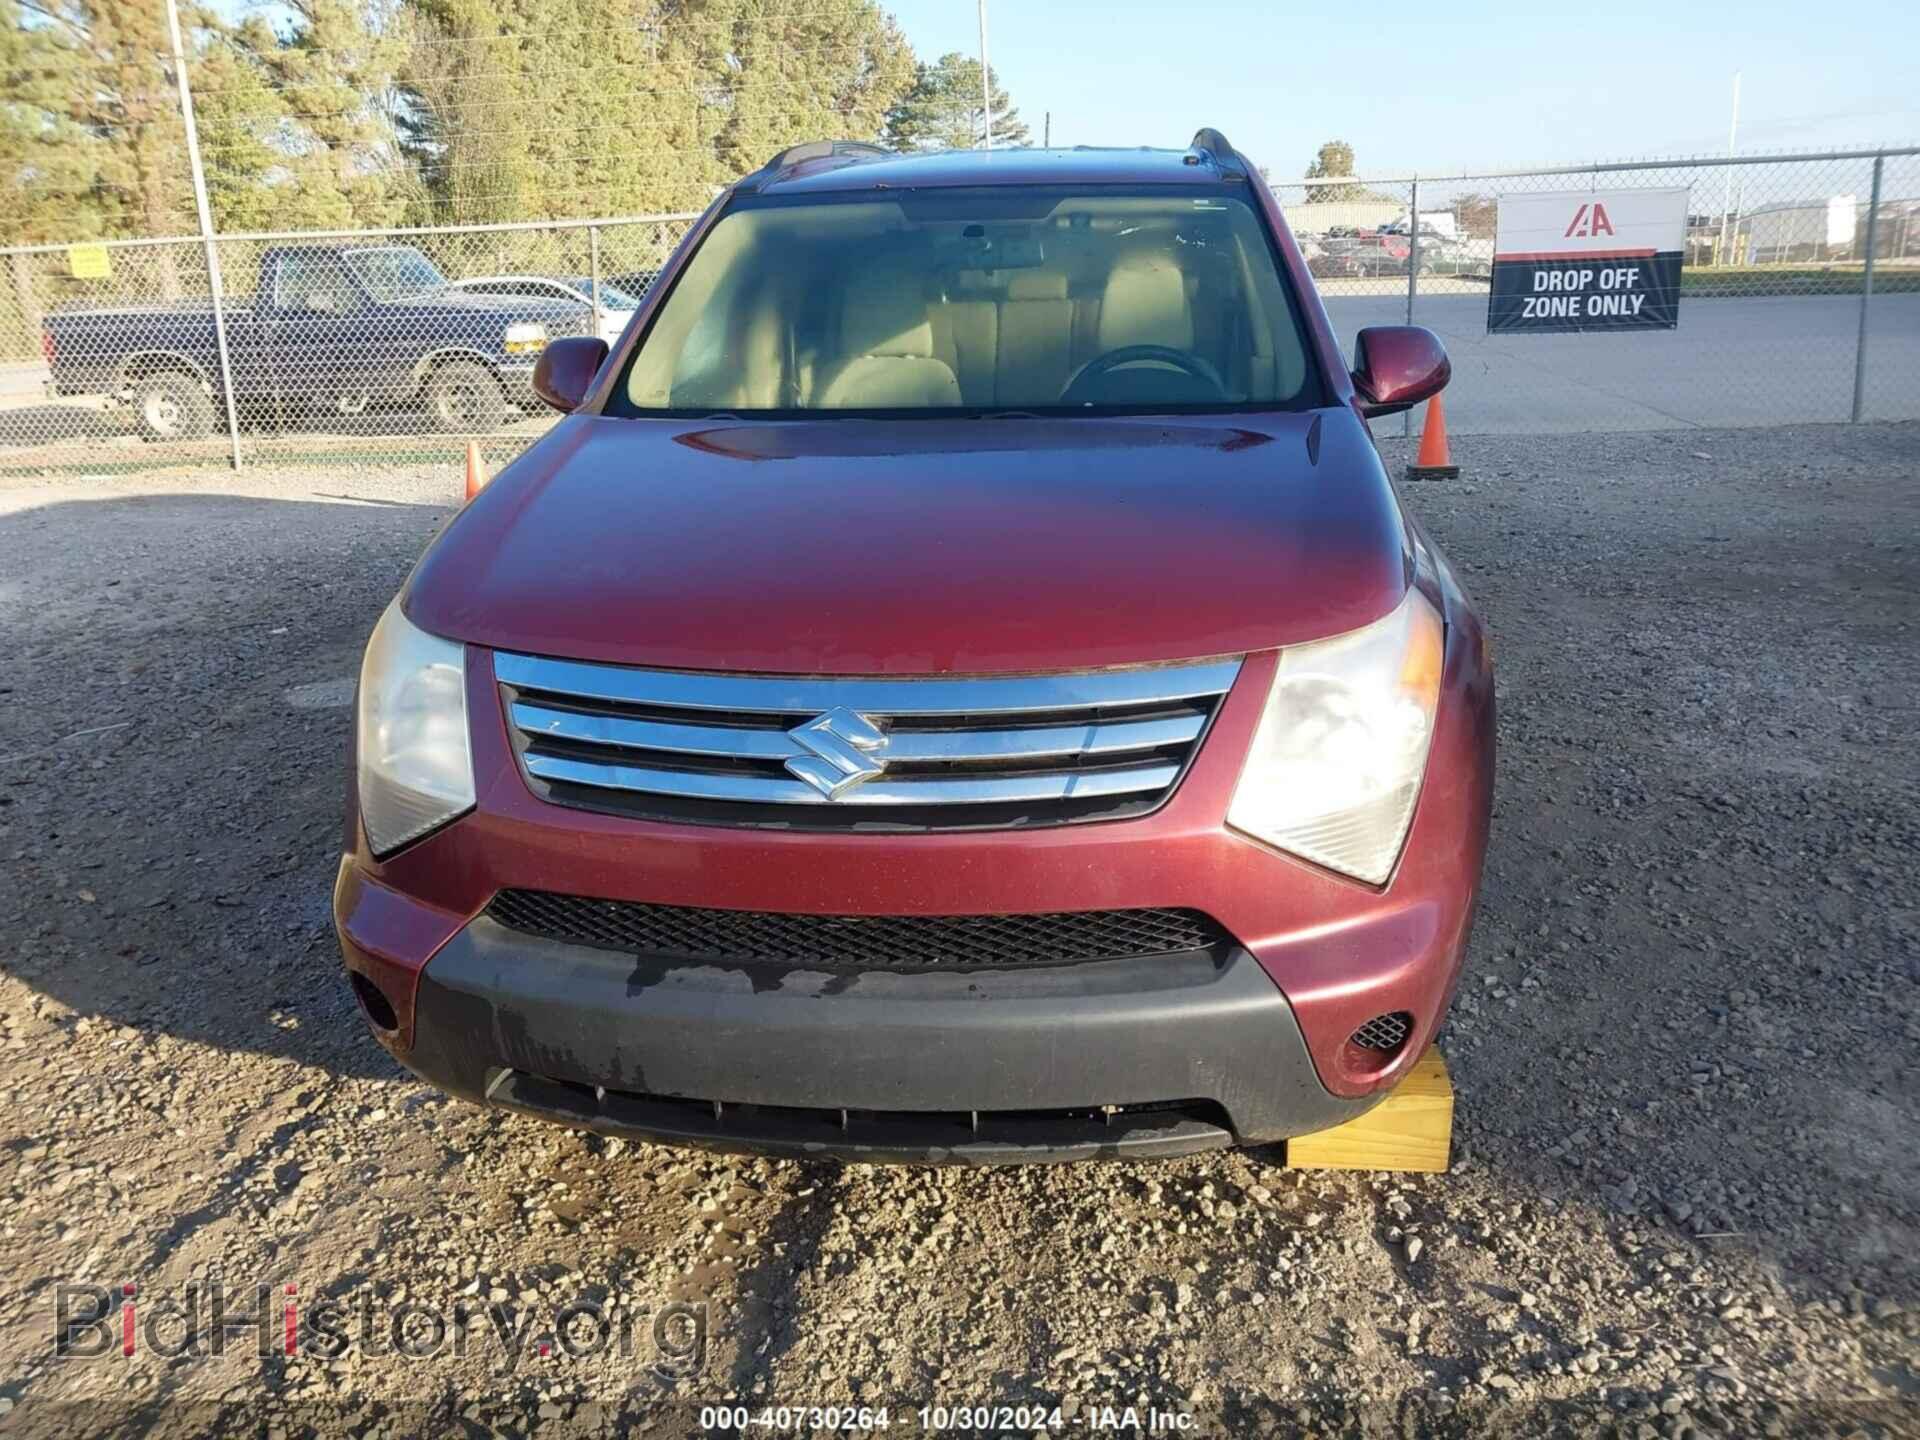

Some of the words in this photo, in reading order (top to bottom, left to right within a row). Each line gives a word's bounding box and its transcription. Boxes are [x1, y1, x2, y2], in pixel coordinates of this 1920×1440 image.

[1533, 270, 1593, 292] DROP
[1599, 268, 1640, 289] OFF
[1522, 296, 1581, 318] ZONE
[1587, 294, 1645, 316] ONLY
